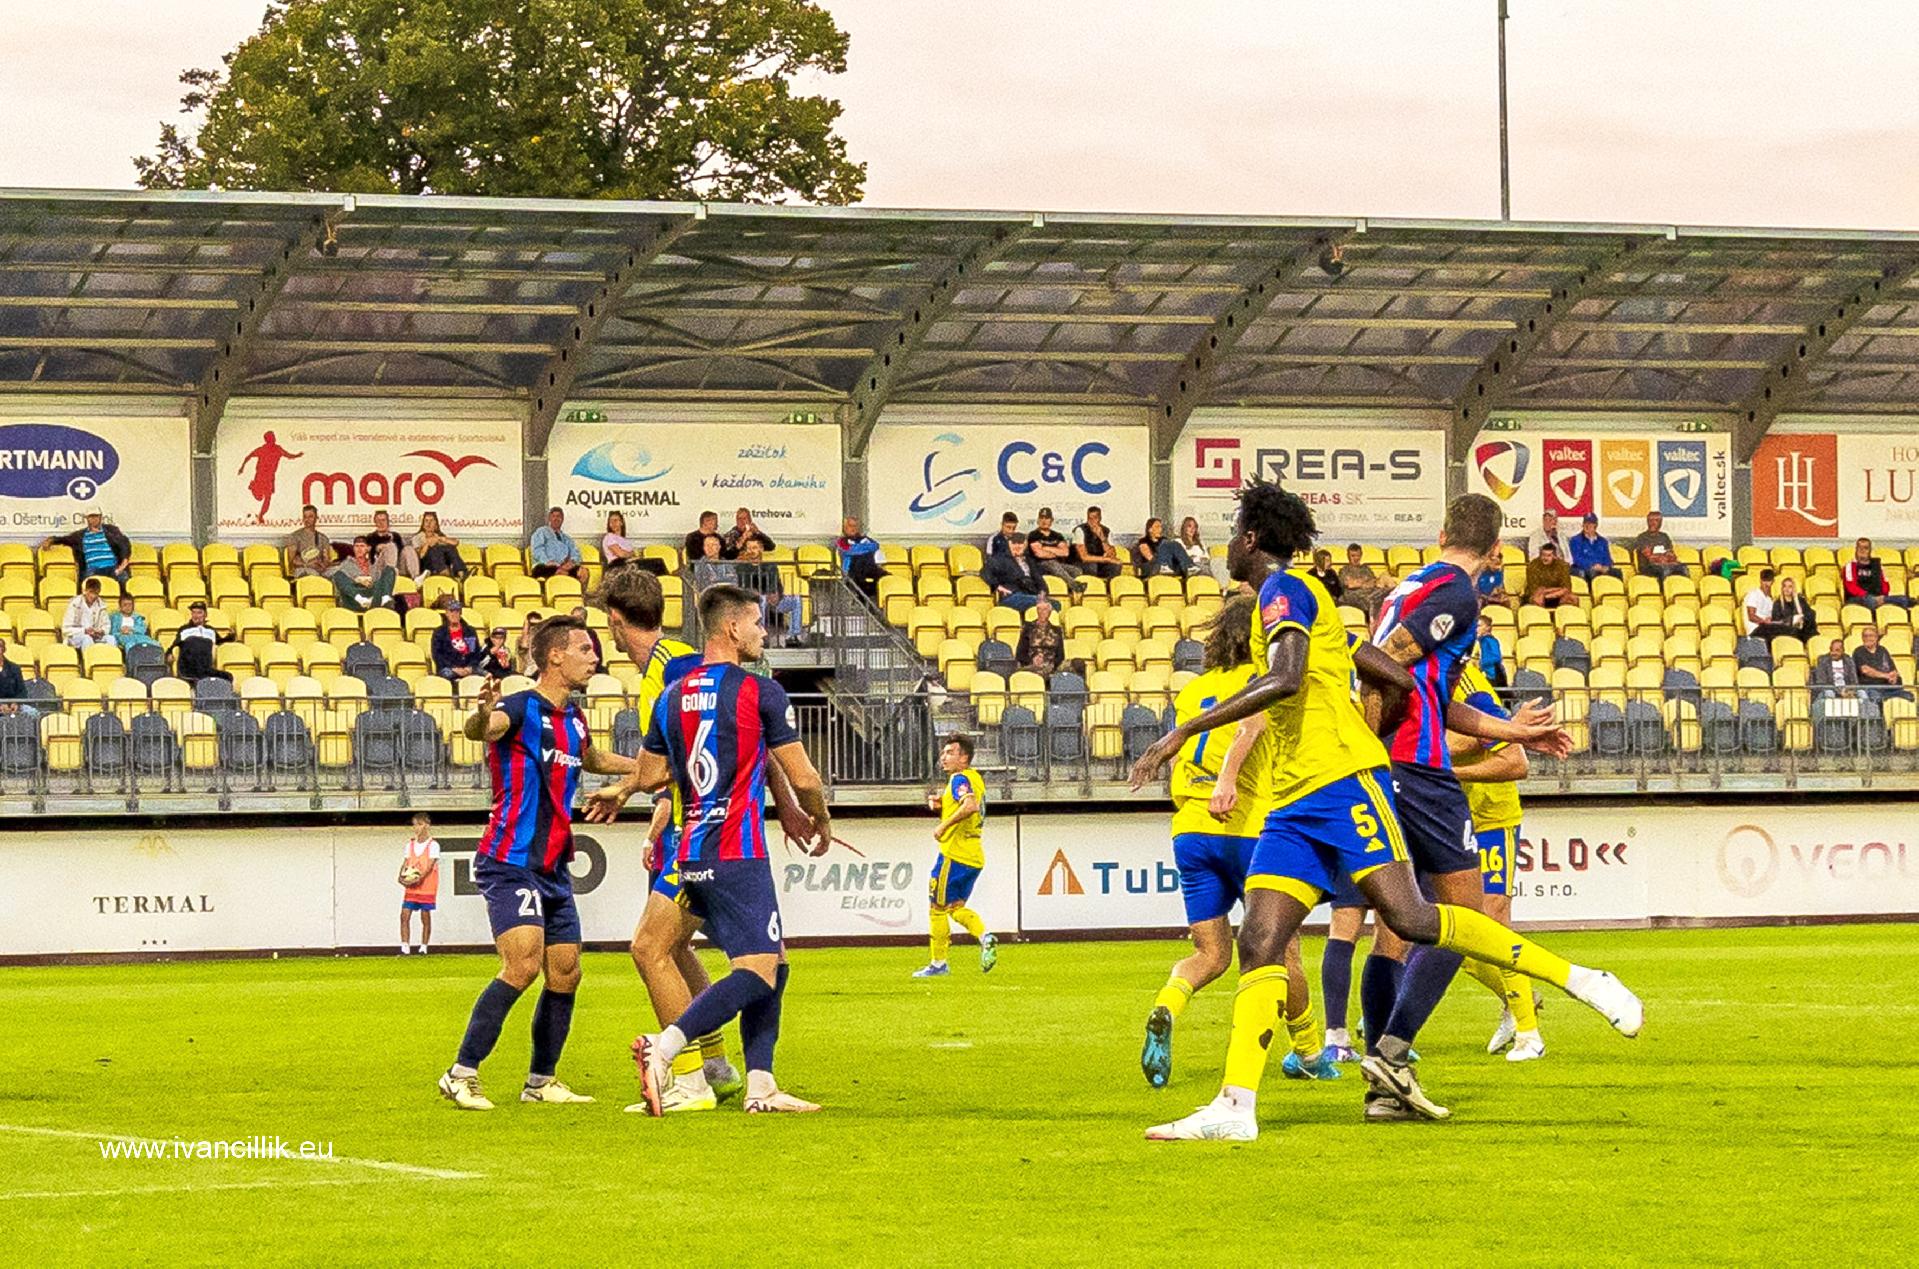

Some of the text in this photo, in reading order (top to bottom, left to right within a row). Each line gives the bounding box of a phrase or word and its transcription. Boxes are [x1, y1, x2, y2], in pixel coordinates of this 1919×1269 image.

[998, 441, 1112, 494] C&C
[1256, 449, 1421, 480] REA-S
[1549, 447, 1587, 461] valtec
[1607, 448, 1644, 462] valtec
[1663, 448, 1701, 462] valtec
[302, 472, 445, 505] maro
[712, 474, 764, 488] každom
[1713, 450, 1727, 520] valtec.sk
[566, 490, 680, 508] AQUATERMAL
[596, 510, 650, 518] STHOVÁ
[682, 692, 717, 712] GONO
[687, 719, 719, 797] 6
[1351, 803, 1378, 838] 5
[1464, 819, 1478, 853] 4
[1479, 845, 1504, 873] 16
[784, 862, 913, 893] PLANEO
[93, 895, 215, 914] TERMAL
[515, 888, 543, 917] 21
[841, 896, 906, 910] Elektro
[767, 911, 780, 942] 6
